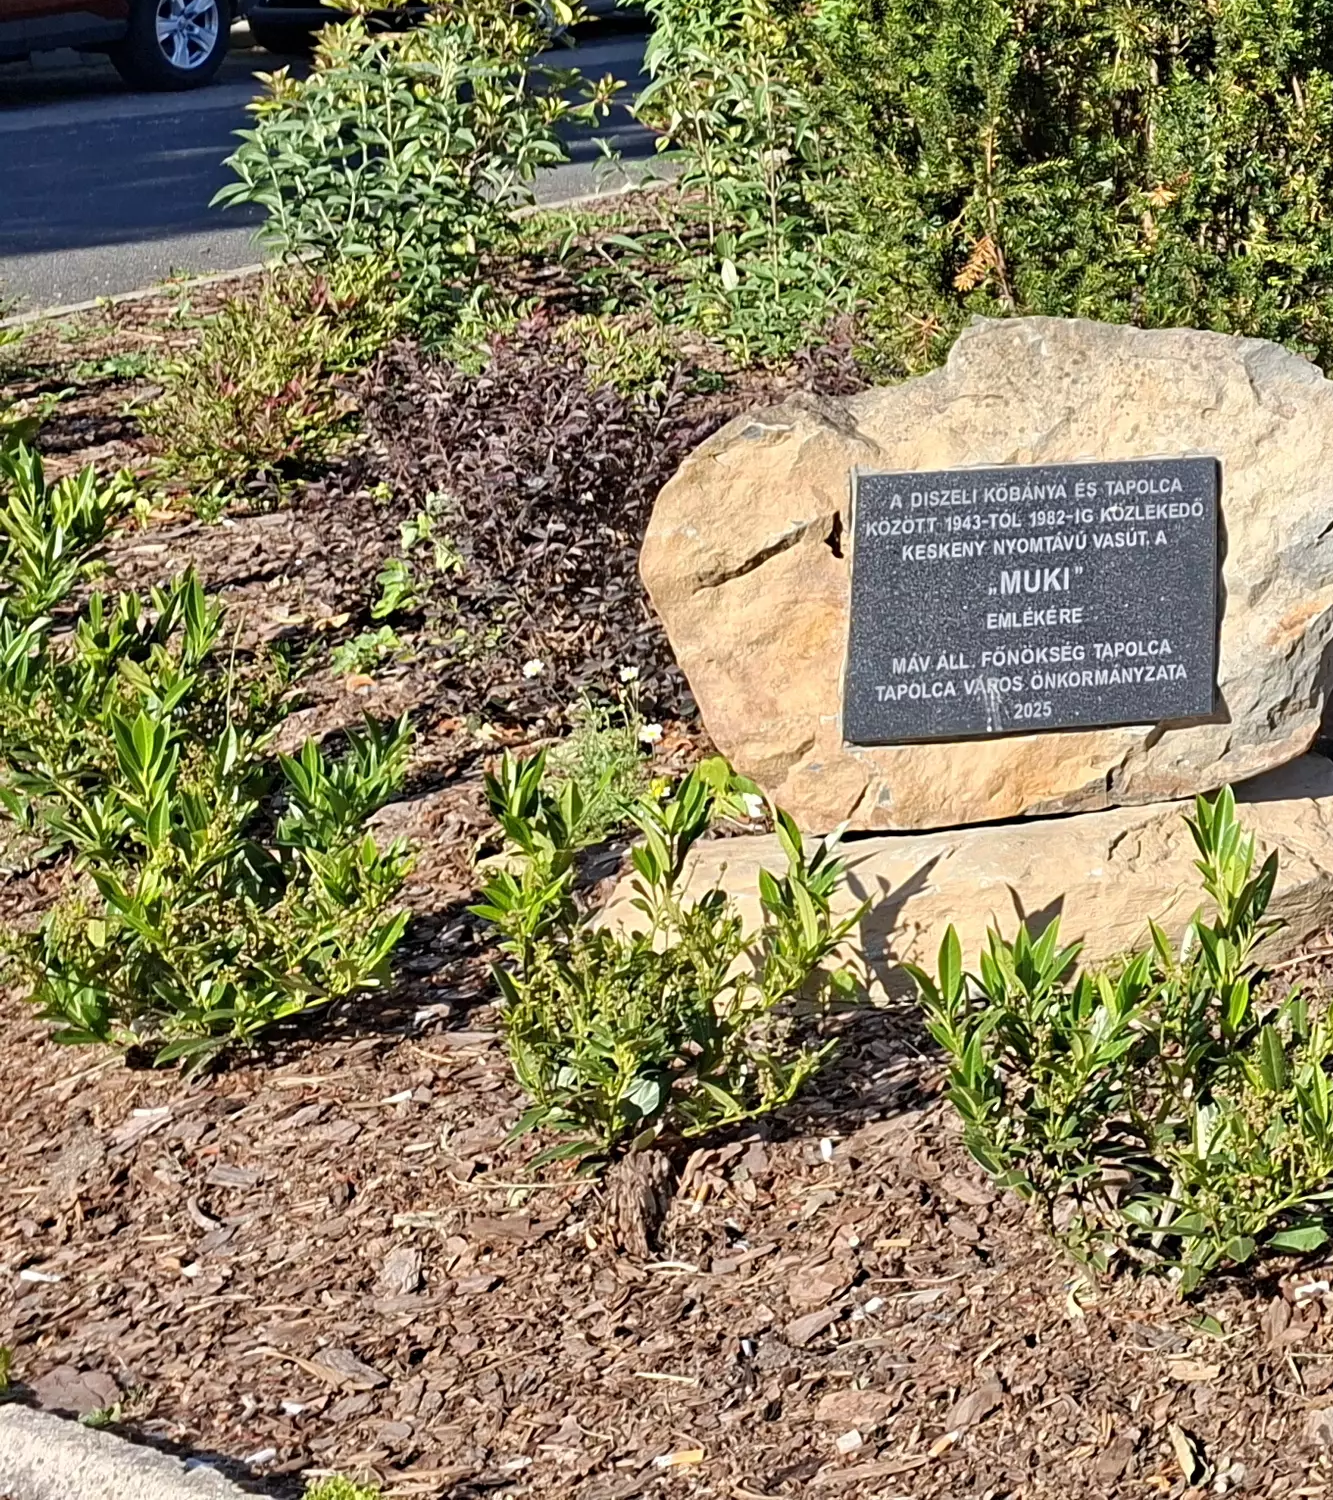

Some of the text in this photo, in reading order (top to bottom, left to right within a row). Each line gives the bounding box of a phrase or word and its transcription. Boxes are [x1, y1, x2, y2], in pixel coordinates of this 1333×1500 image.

[889, 477, 1183, 510] A DISZELI KŐBÁNYA ÉS TAPOLCA
[866, 497, 1204, 537] KÖZÖTT 1943-TÓL 1982-IG KÖZLEKEDŐ
[902, 539, 986, 562] KESKENY
[993, 529, 1087, 556] NYOMTÁVÚ
[1154, 529, 1168, 546] A
[986, 605, 1083, 630] EMLÉKÉRE
[892, 652, 931, 675] MÁV
[981, 640, 1086, 667] FŐNÖKSÉG
[1093, 638, 1172, 660] TAPOLCA
[875, 663, 1188, 702] TAPOLCA VÁROS ÖNKORMÁNYZATA
[1013, 701, 1052, 720] 2025
